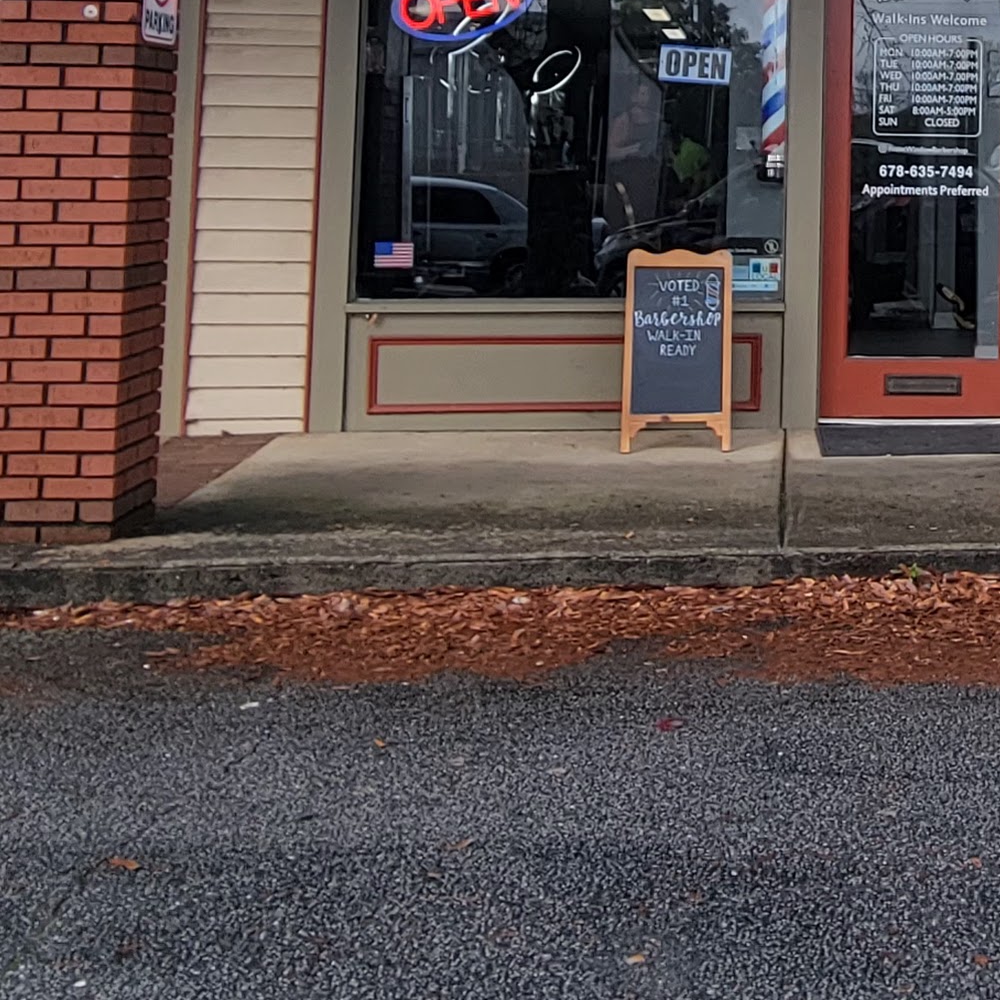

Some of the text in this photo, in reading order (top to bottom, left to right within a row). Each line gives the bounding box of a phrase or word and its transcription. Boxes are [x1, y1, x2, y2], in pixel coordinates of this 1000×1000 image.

[144, 9, 175, 35] PARKING
[871, 12, 988, 26] Walk-Ins Welcome
[899, 33, 963, 44] OPEN HOURS
[880, 47, 903, 57] MON
[665, 49, 727, 80] OPEN
[880, 59, 898, 68] TUE
[880, 71, 902, 80] WED
[880, 82, 899, 92] THU
[879, 94, 892, 103] FRI
[879, 105, 895, 114] SAT
[878, 117, 960, 127] SUN CLOSED
[879, 164, 974, 178] 678-635-7494
[861, 183, 989, 198] Appointments Preferred
[659, 279, 699, 292] VOTED
[672, 295, 689, 307] #1
[646, 329, 701, 341] WALK-IN
[660, 344, 696, 356] READY
